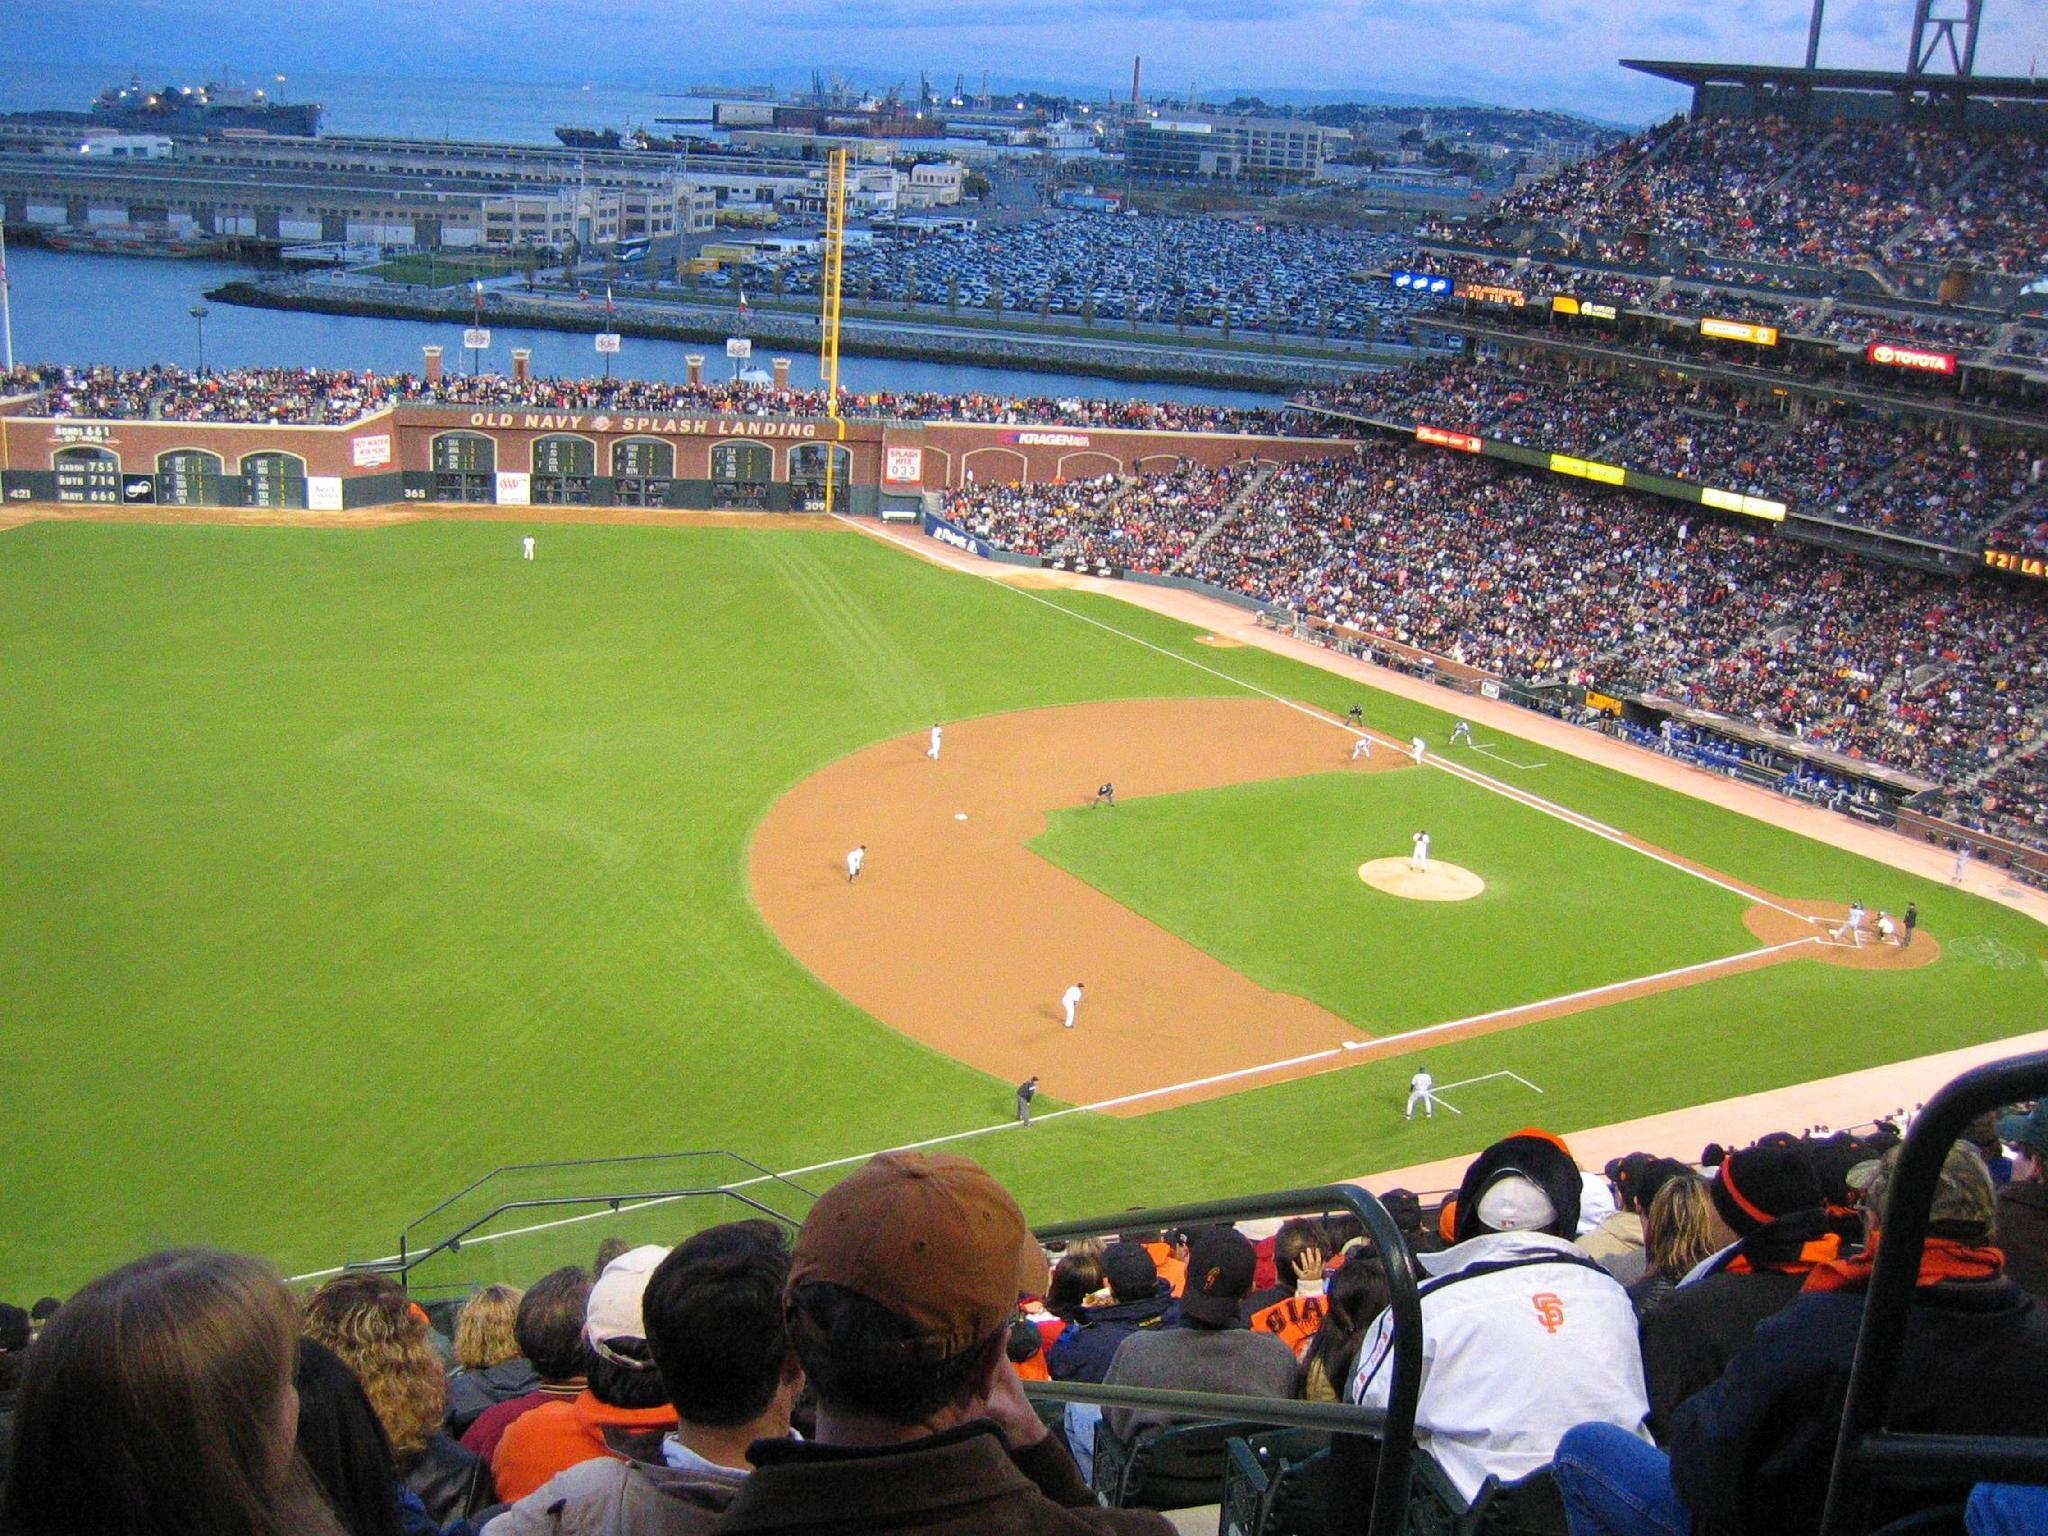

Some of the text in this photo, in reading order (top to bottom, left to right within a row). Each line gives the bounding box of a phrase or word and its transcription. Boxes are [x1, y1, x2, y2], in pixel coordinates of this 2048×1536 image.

[1894, 351, 1946, 369] TOYOTA
[470, 413, 816, 437] OLD NAVY SPLASH LANDING
[86, 426, 110, 437] 661
[1019, 433, 1073, 446] KRAGEN
[89, 462, 113, 472] 755
[892, 466, 916, 475] 033
[59, 475, 115, 486] RUTH 714
[10, 489, 31, 498] 421
[61, 490, 115, 501] MAYS 660
[404, 489, 425, 498] 365
[805, 502, 825, 510] 309
[1532, 1293, 1563, 1333] SF
